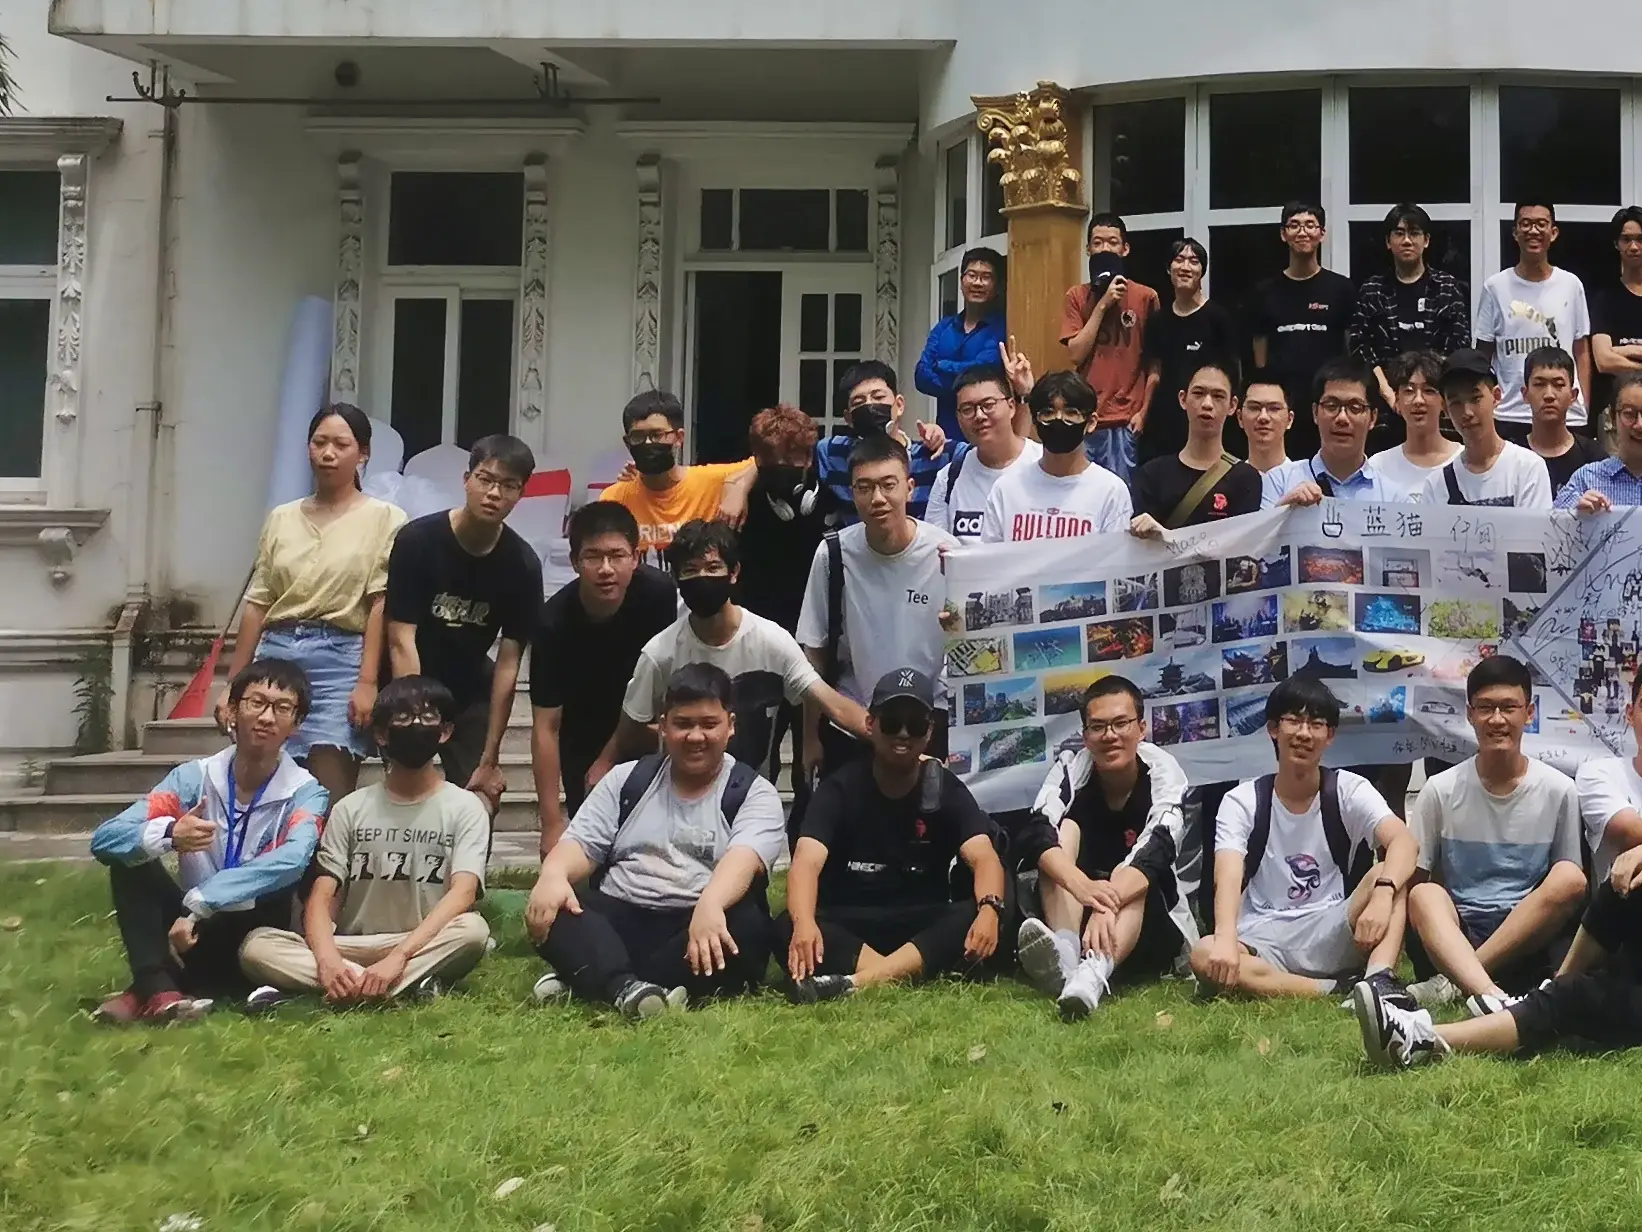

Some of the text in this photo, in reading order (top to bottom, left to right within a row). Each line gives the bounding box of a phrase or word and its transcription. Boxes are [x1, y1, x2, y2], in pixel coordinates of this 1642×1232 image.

[906, 588, 929, 605] Tee
[352, 827, 383, 842] EEP
[385, 828, 400, 842] IT
